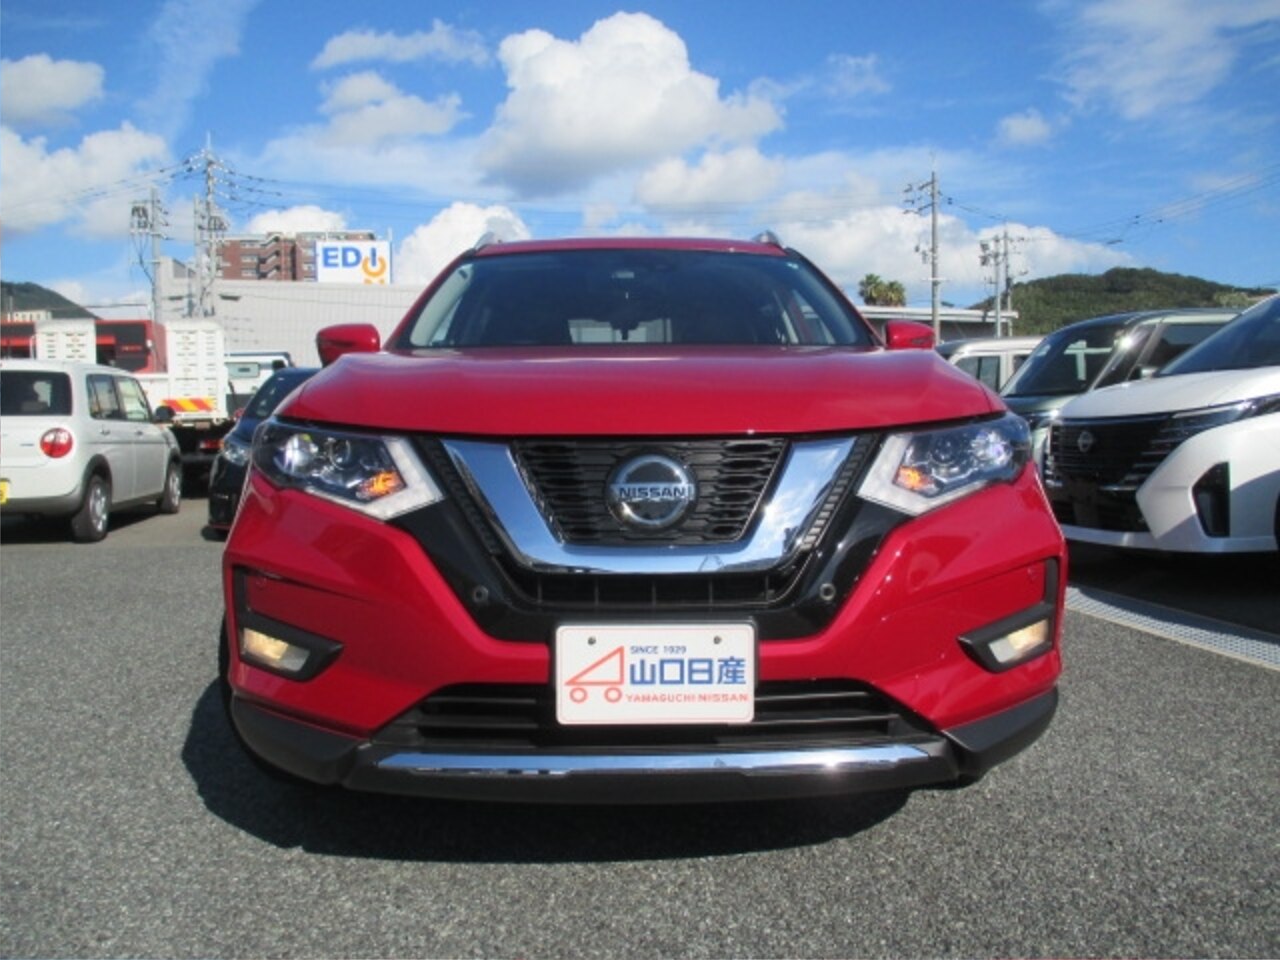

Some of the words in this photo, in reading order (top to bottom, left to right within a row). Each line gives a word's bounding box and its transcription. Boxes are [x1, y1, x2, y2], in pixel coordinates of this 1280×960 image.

[620, 486, 686, 499] NISSAN
[630, 645, 659, 655] SINCE
[629, 656, 747, 685] 山口日産
[626, 693, 696, 703] YAMAGUCHI
[697, 693, 749, 702] NISSAN
